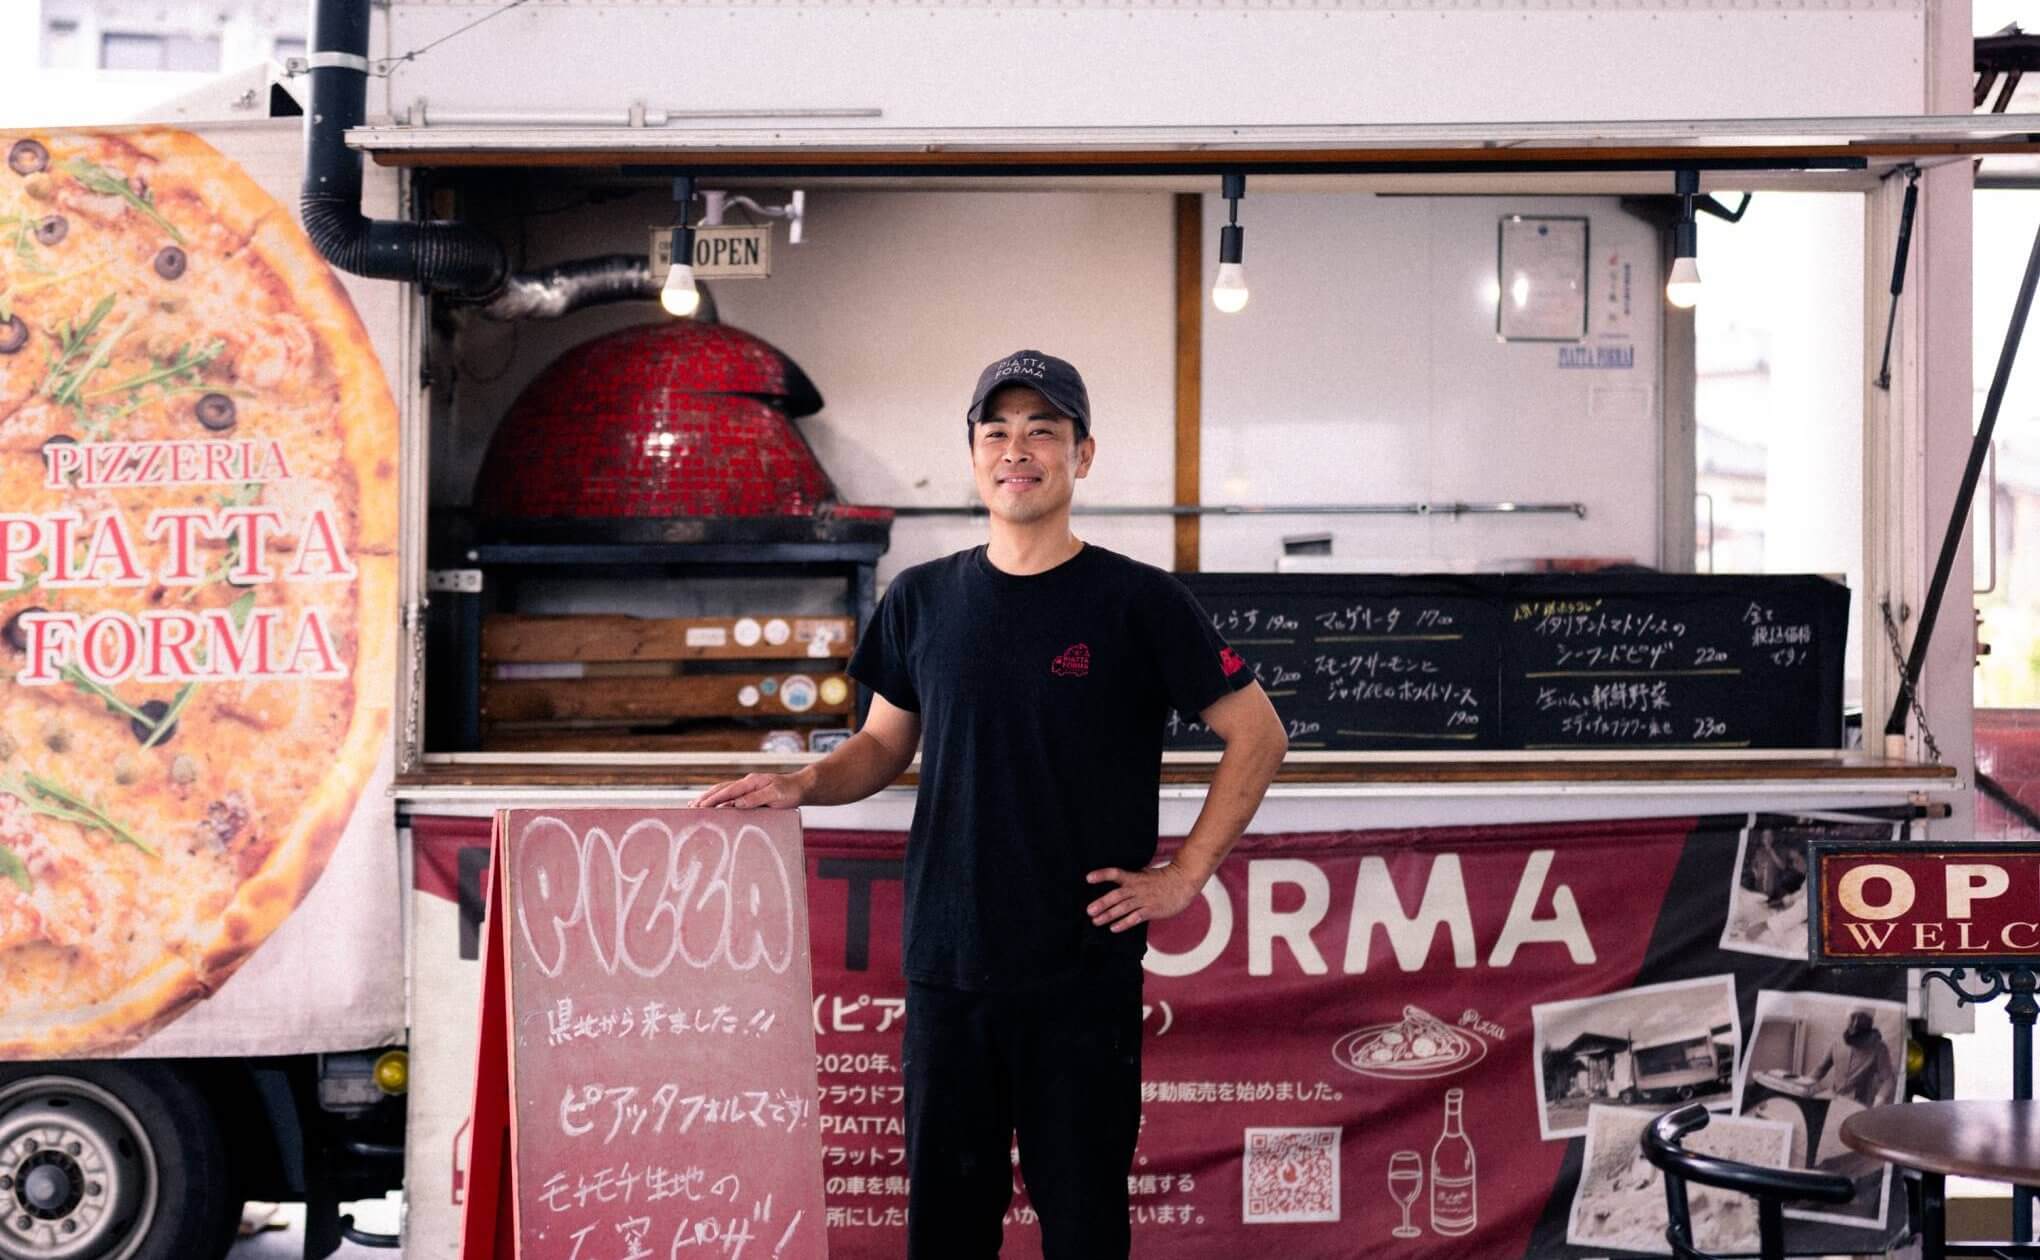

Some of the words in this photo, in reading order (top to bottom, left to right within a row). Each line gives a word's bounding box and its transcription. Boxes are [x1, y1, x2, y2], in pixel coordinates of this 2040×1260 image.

[696, 237, 760, 266] OPEN
[995, 367, 1044, 380] FORMA
[998, 358, 1046, 371] PIATTA
[46, 440, 292, 486] PIZZERIA
[0, 507, 354, 586] PIATTA
[21, 609, 342, 682] FORMA
[516, 816, 794, 978] PIZZA
[1142, 849, 1598, 977] ORMA
[1838, 863, 2040, 921] OP
[1843, 921, 2040, 952] WELC
[820, 1114, 906, 1136] PIATTA
